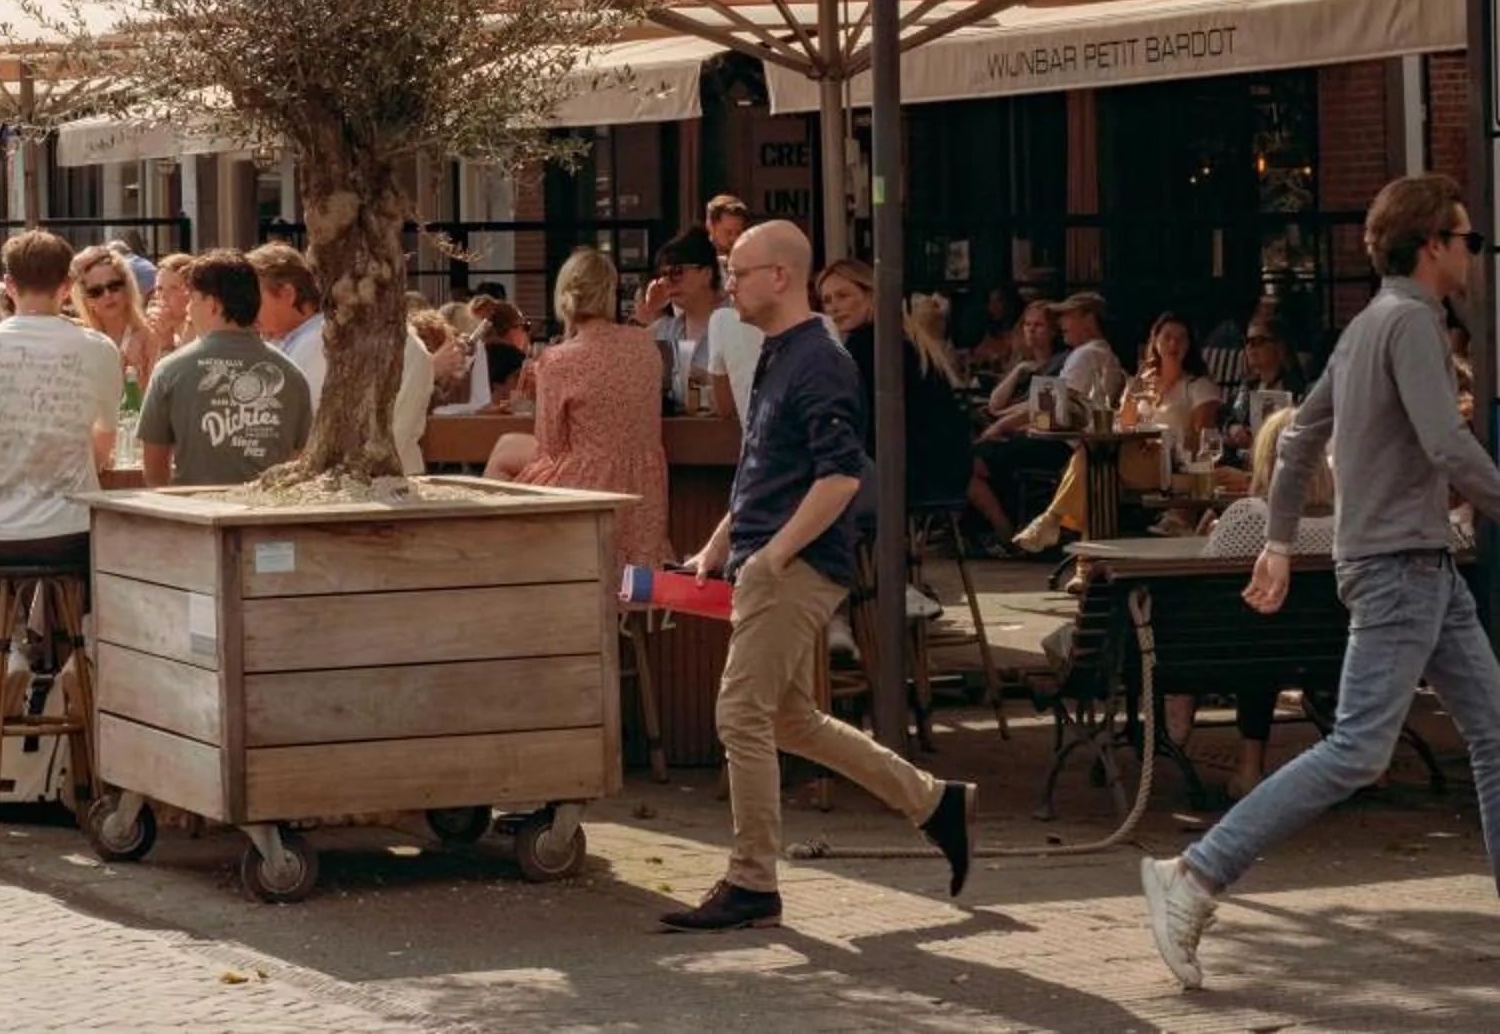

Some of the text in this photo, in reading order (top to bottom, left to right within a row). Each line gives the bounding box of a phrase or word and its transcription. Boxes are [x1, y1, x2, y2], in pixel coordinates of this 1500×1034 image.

[987, 27, 1237, 79] WIJNBAR PETIT BARDOT
[761, 142, 809, 166] CRE
